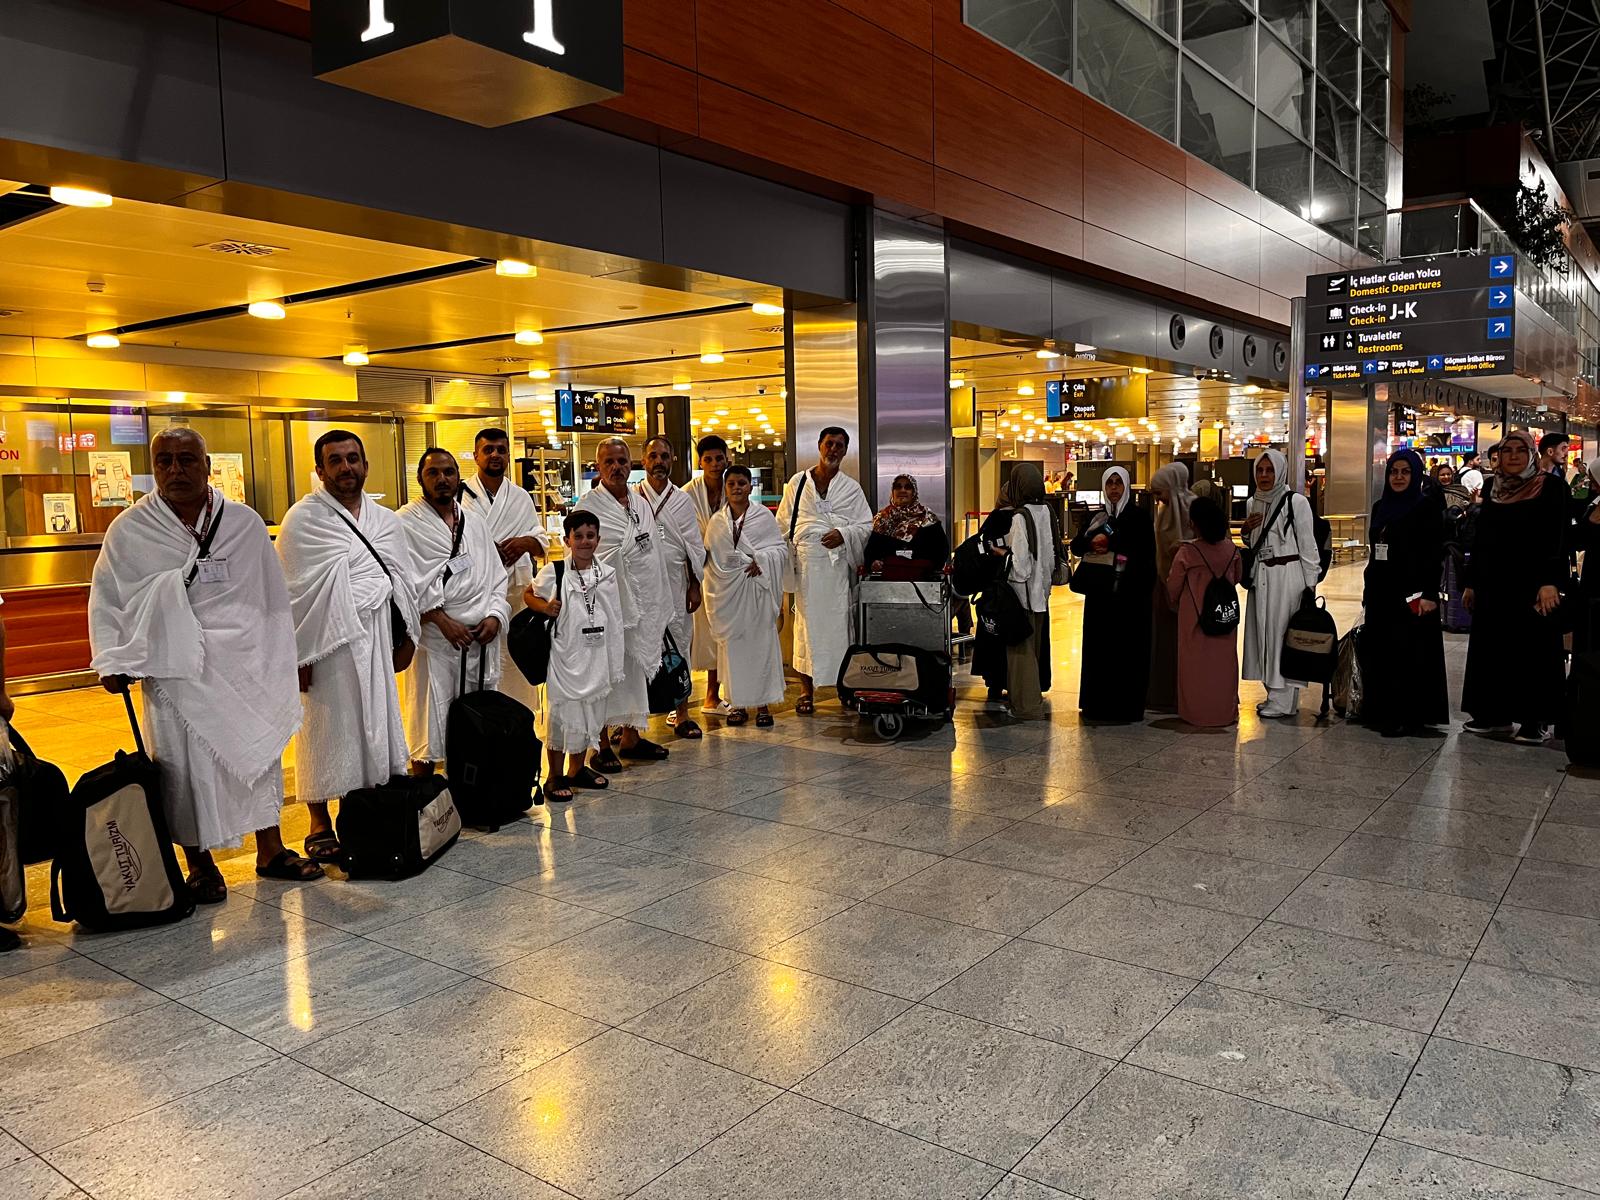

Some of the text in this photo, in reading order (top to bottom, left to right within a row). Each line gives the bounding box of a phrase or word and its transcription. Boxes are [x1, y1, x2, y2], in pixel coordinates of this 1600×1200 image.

[1350, 268, 1441, 287] İç Hatlar Giden Yolcu
[1350, 280, 1441, 297] Domestic Departures
[1350, 303, 1386, 315] Check-in
[1389, 301, 1418, 320] J-K
[1350, 315, 1386, 326] Check-in
[1358, 330, 1402, 343] Tuvaletler
[1358, 342, 1403, 354] Restrooms
[1444, 363, 1478, 372] Immigration
[118, 859, 135, 892] YAKUT
